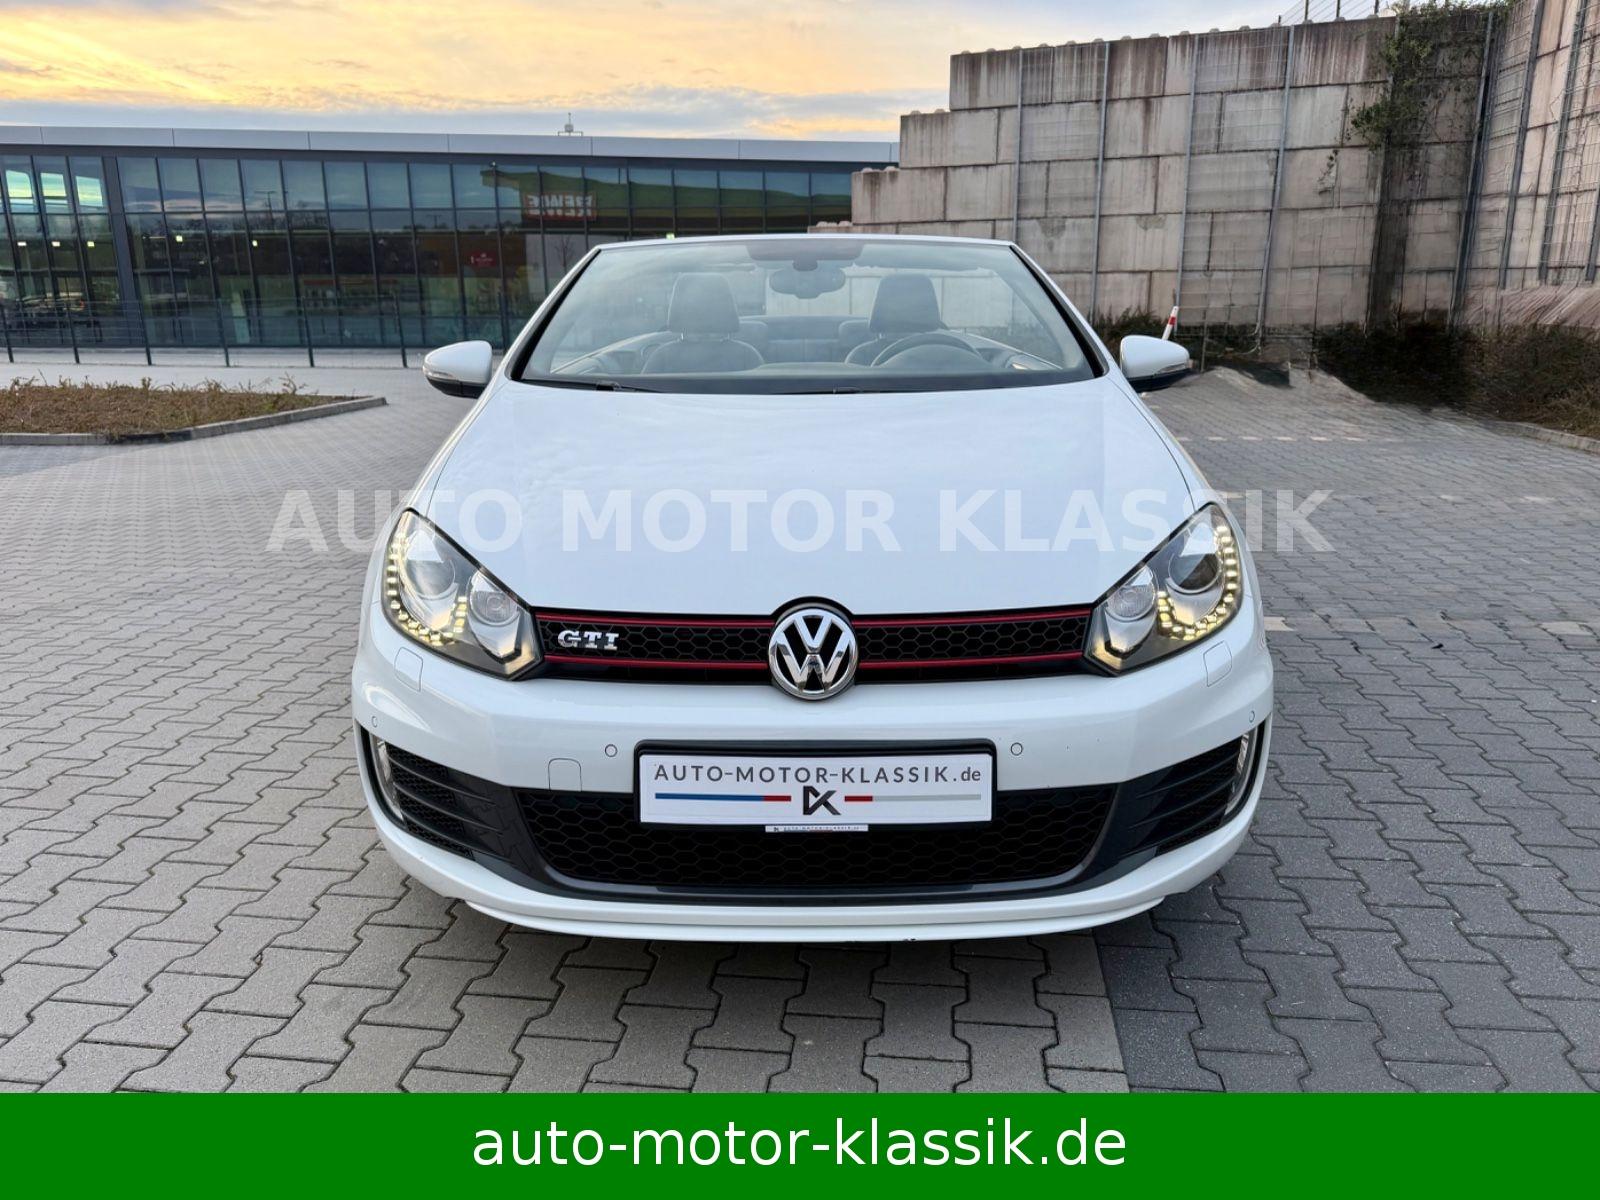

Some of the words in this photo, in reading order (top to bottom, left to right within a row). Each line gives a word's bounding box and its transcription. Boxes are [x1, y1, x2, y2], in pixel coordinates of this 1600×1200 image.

[557, 630, 620, 651] GTI
[770, 609, 858, 700] VW
[654, 764, 982, 784] AUTO-MOTOR-KLASSIK.de
